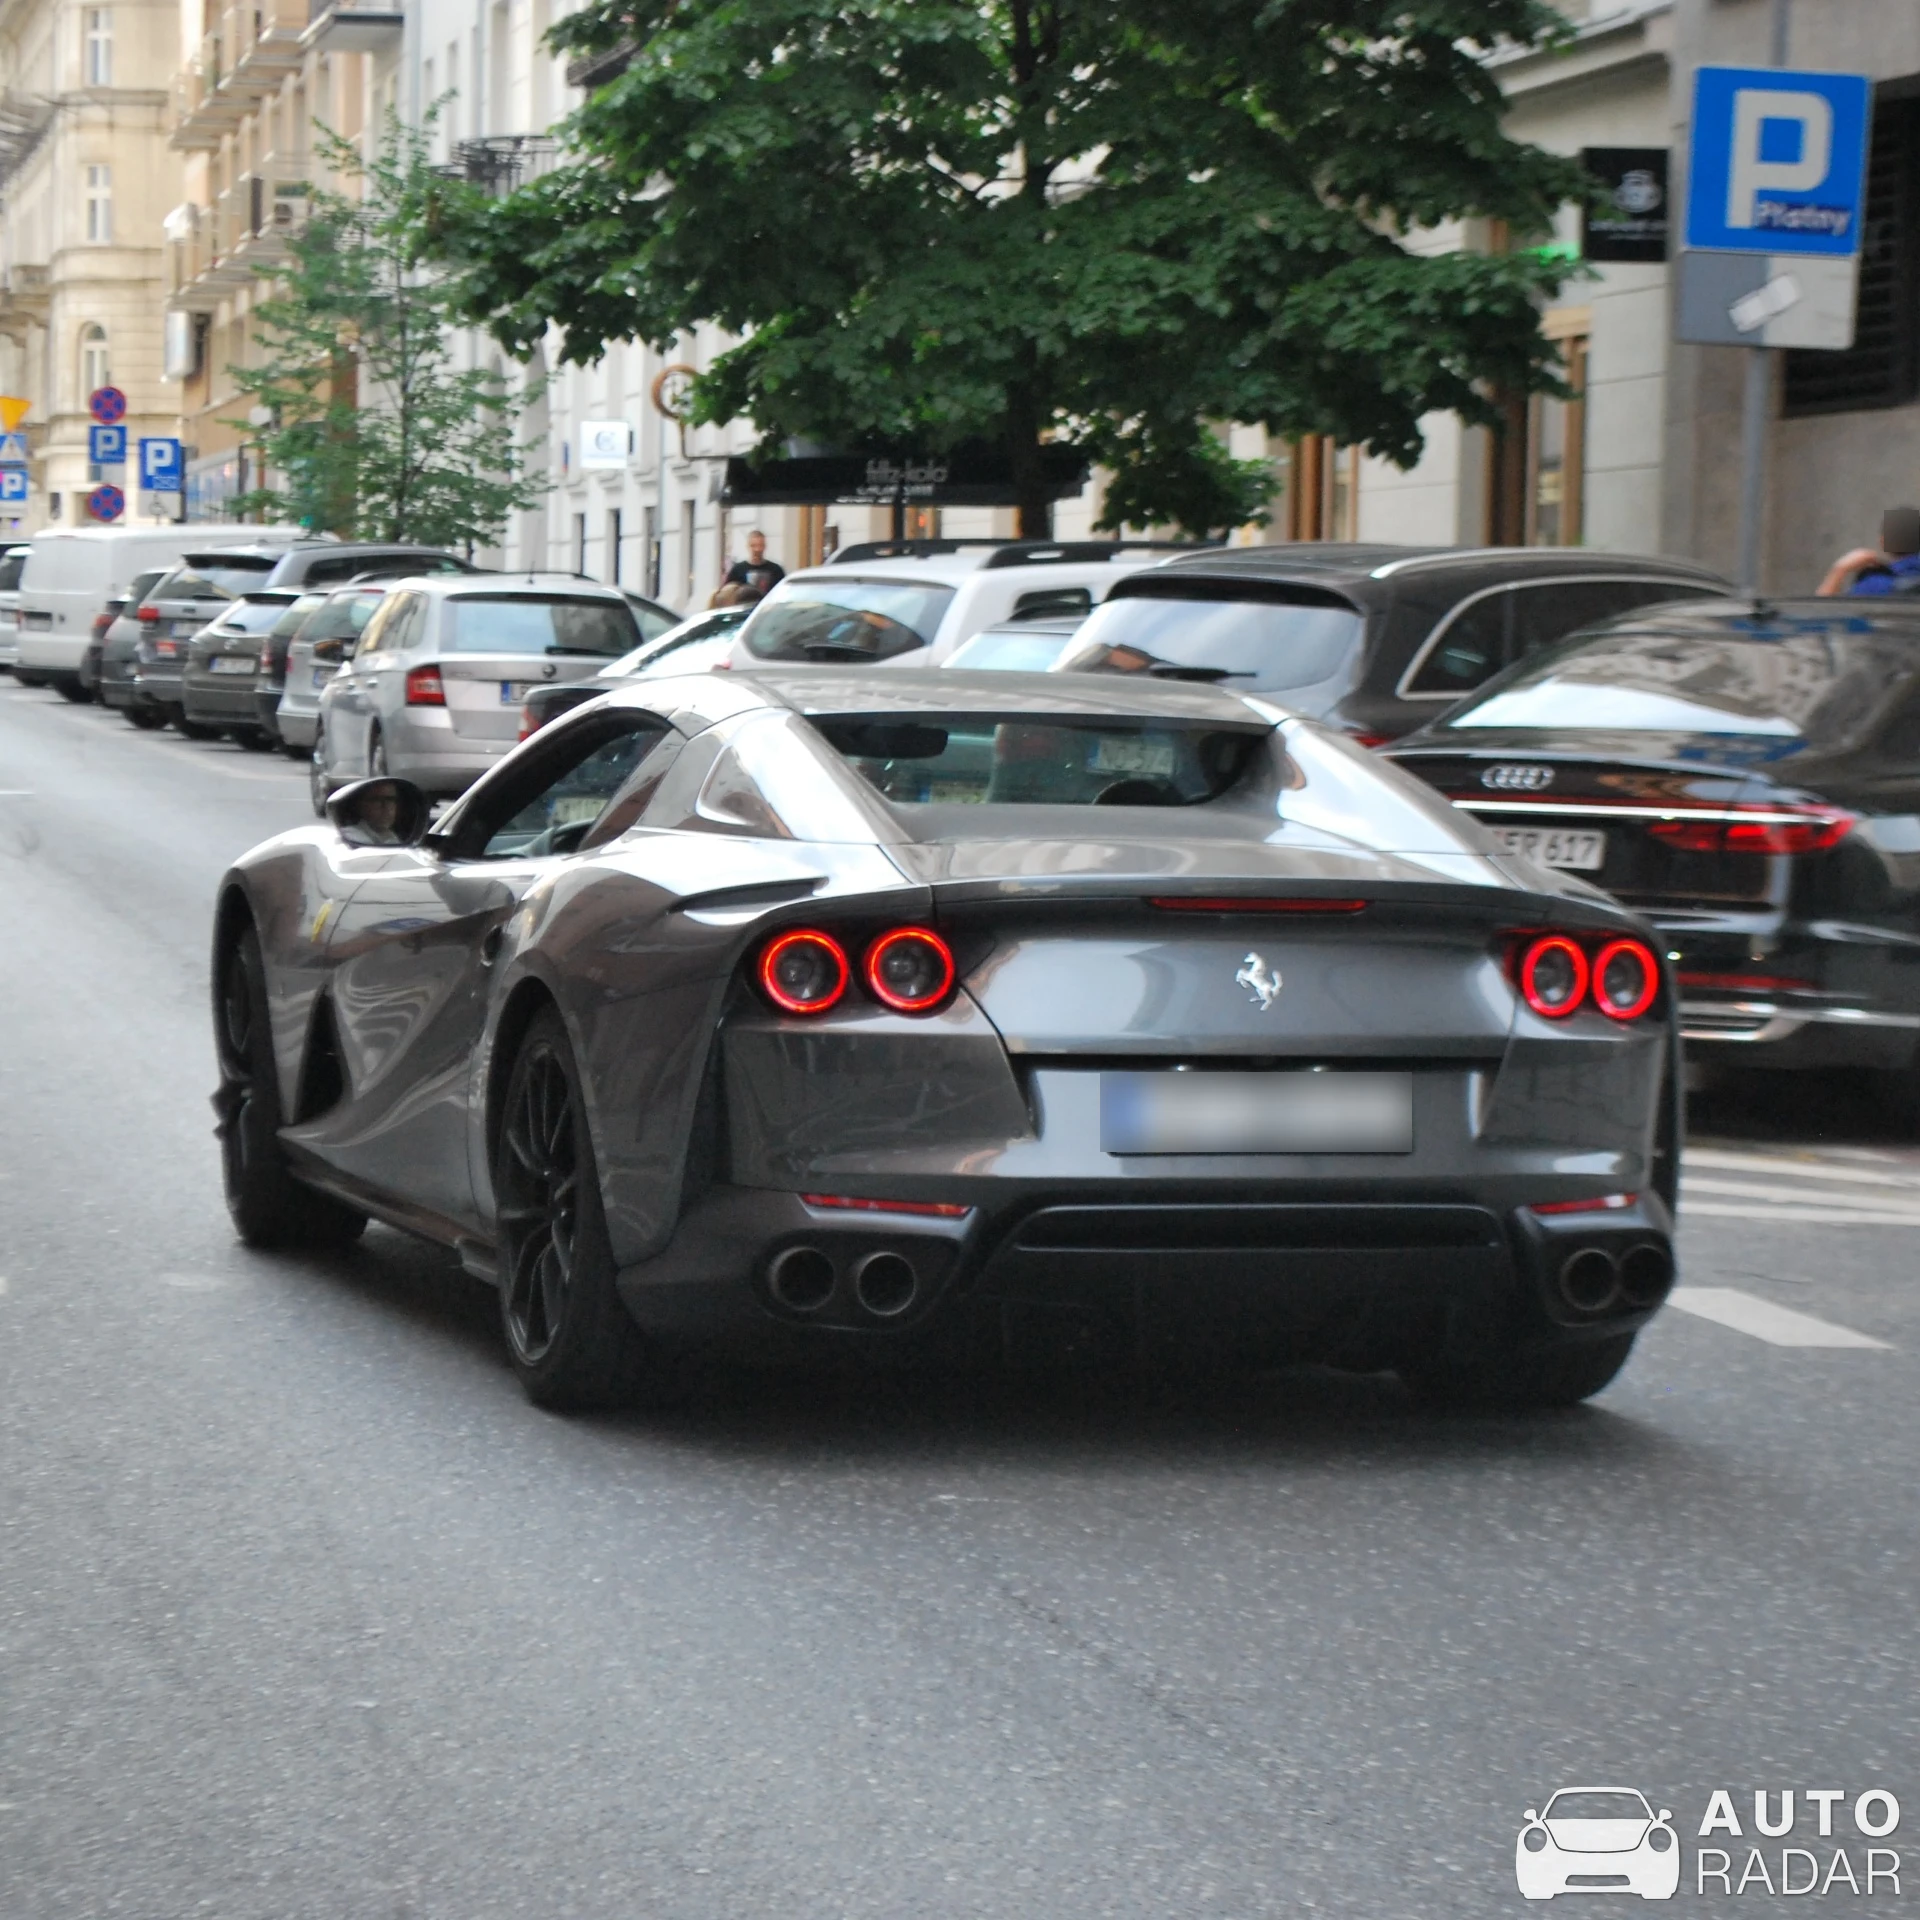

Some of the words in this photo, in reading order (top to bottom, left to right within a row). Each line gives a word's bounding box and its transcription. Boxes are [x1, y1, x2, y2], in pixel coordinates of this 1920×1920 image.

[1725, 88, 1834, 228] P
[96, 429, 120, 459] P
[146, 441, 173, 476] P
[2, 473, 23, 498] P
